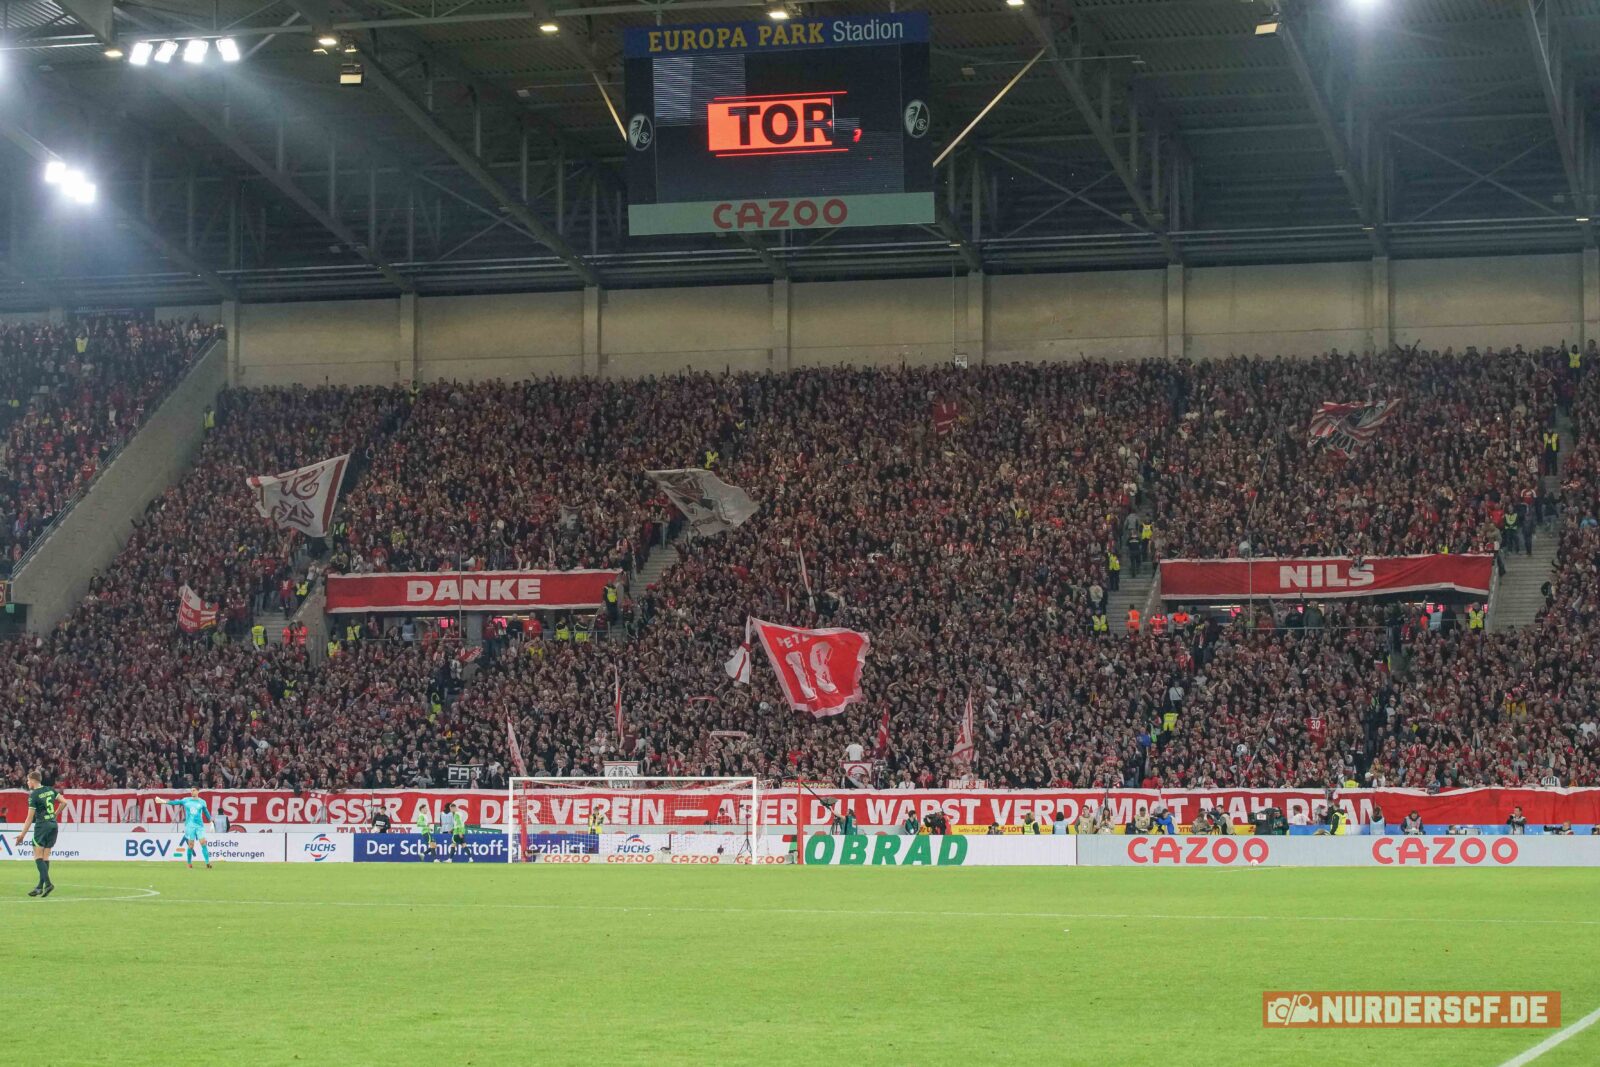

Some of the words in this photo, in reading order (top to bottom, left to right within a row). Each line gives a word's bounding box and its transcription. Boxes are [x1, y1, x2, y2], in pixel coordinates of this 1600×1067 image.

[649, 26, 747, 52] EUROPA
[758, 23, 824, 46] PARK
[833, 19, 903, 42] Stadion
[728, 102, 832, 146] TOR
[713, 198, 848, 229] CAZOO
[1279, 563, 1375, 589] NILS
[406, 578, 541, 602] DANKE
[785, 641, 839, 701] 18
[45, 796, 55, 814] 5
[211, 795, 258, 823] IST
[480, 798, 542, 824] DER
[550, 797, 665, 825] VEREIN
[717, 798, 798, 825] ABER
[125, 839, 172, 857] BGV
[206, 839, 240, 848] adische
[304, 843, 337, 852] FUCHS
[366, 840, 396, 855] Der
[616, 844, 651, 854] FUCHS
[1127, 837, 1269, 864] CAZOO
[1372, 837, 1518, 865] CAZOO
[208, 848, 265, 859] ersicherungen
[544, 854, 591, 863] CAZOO
[607, 854, 655, 863] CAZOO
[671, 855, 720, 864] CAZOO
